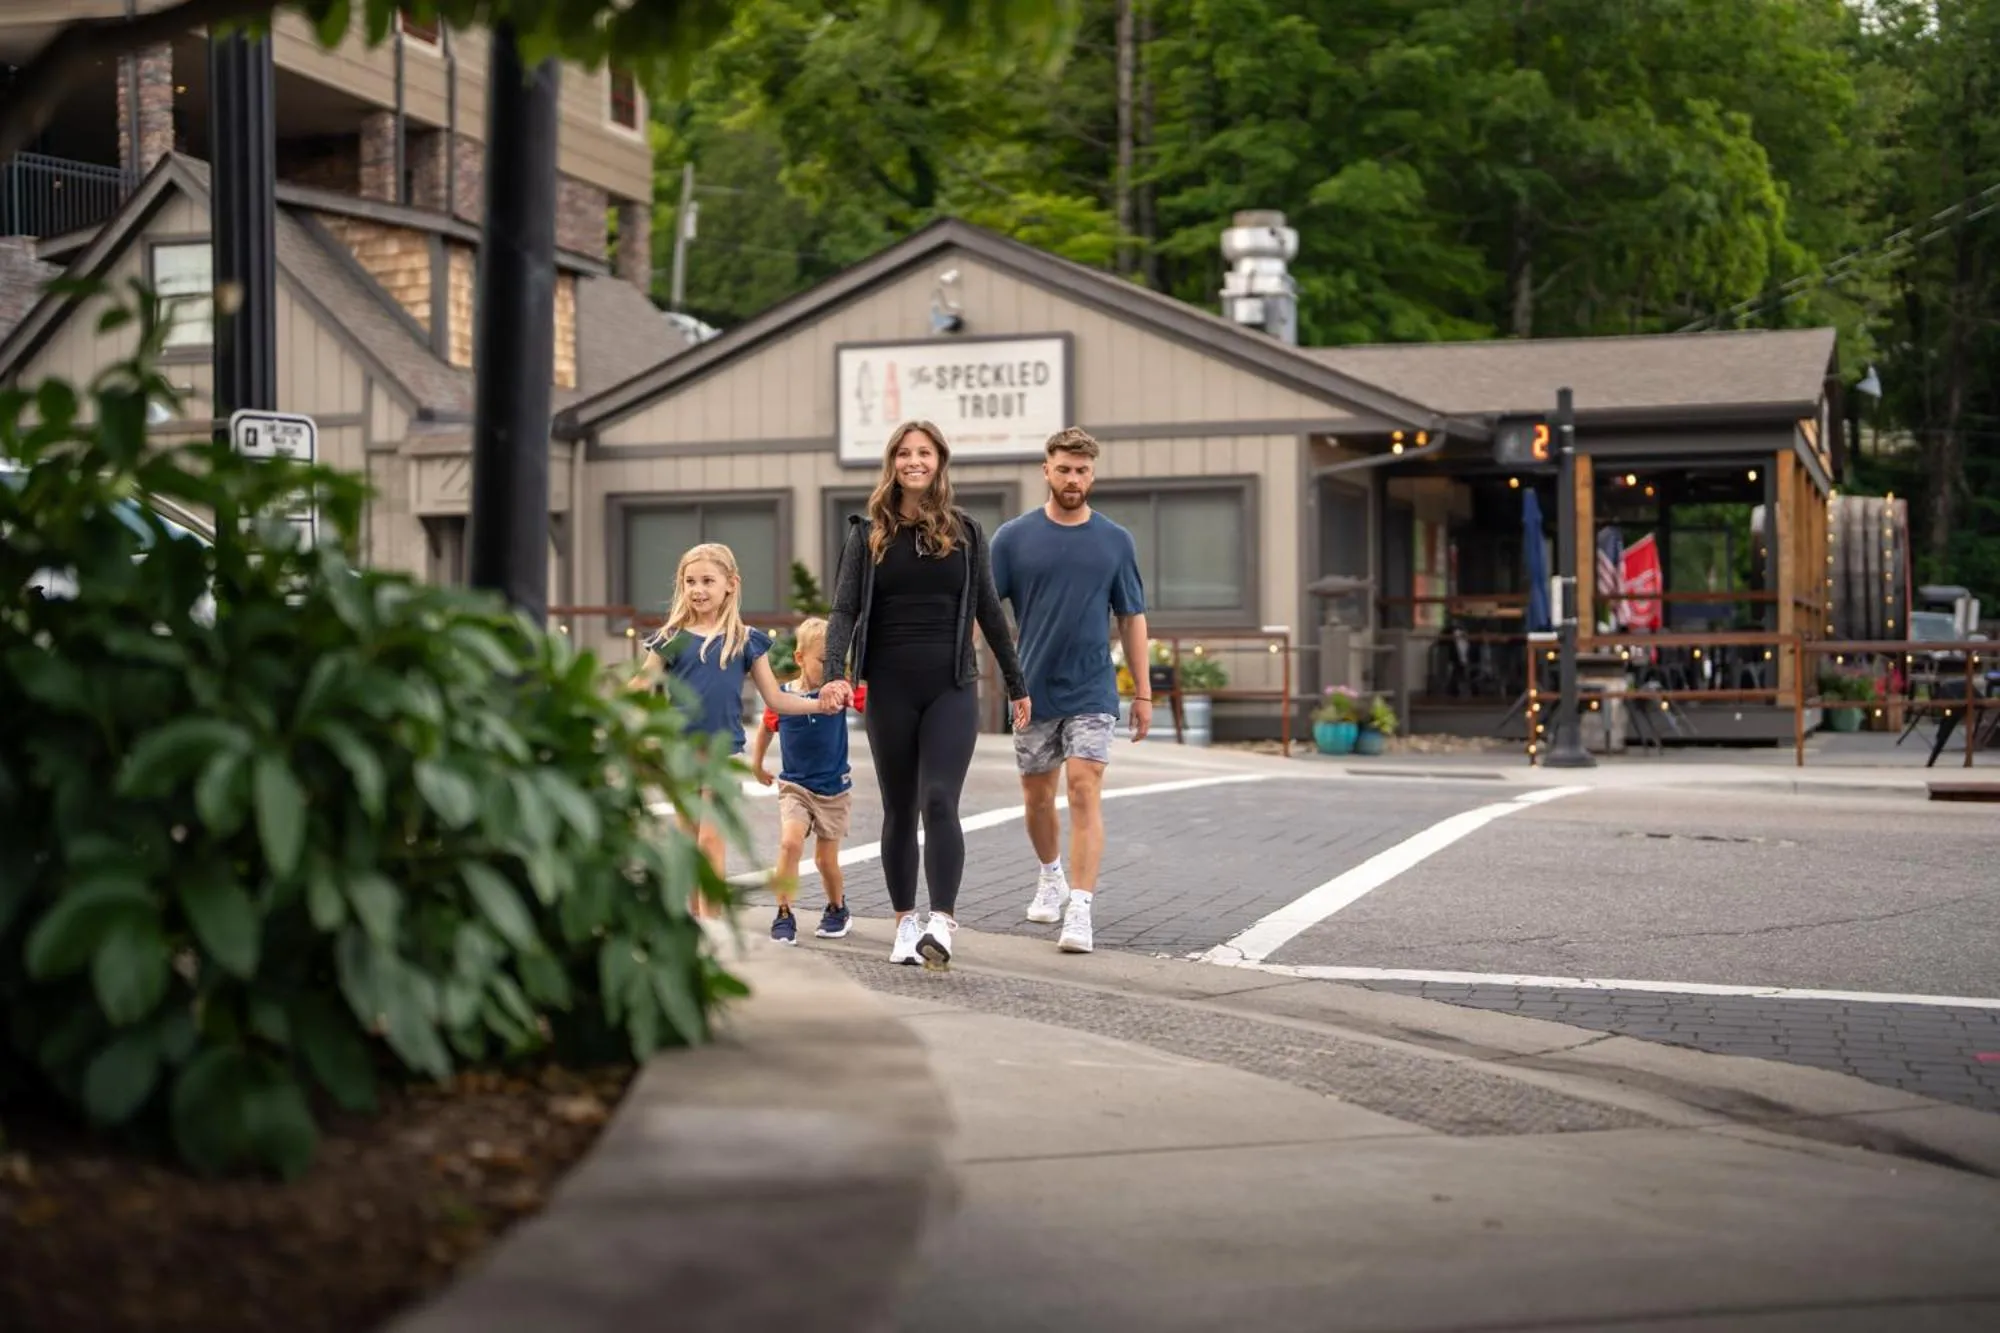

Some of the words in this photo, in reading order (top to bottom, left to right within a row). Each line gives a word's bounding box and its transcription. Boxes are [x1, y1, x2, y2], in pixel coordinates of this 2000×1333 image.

[935, 361, 1050, 390] SPECKLED
[958, 392, 1027, 419] TROUT
[1533, 424, 1549, 459] 2
